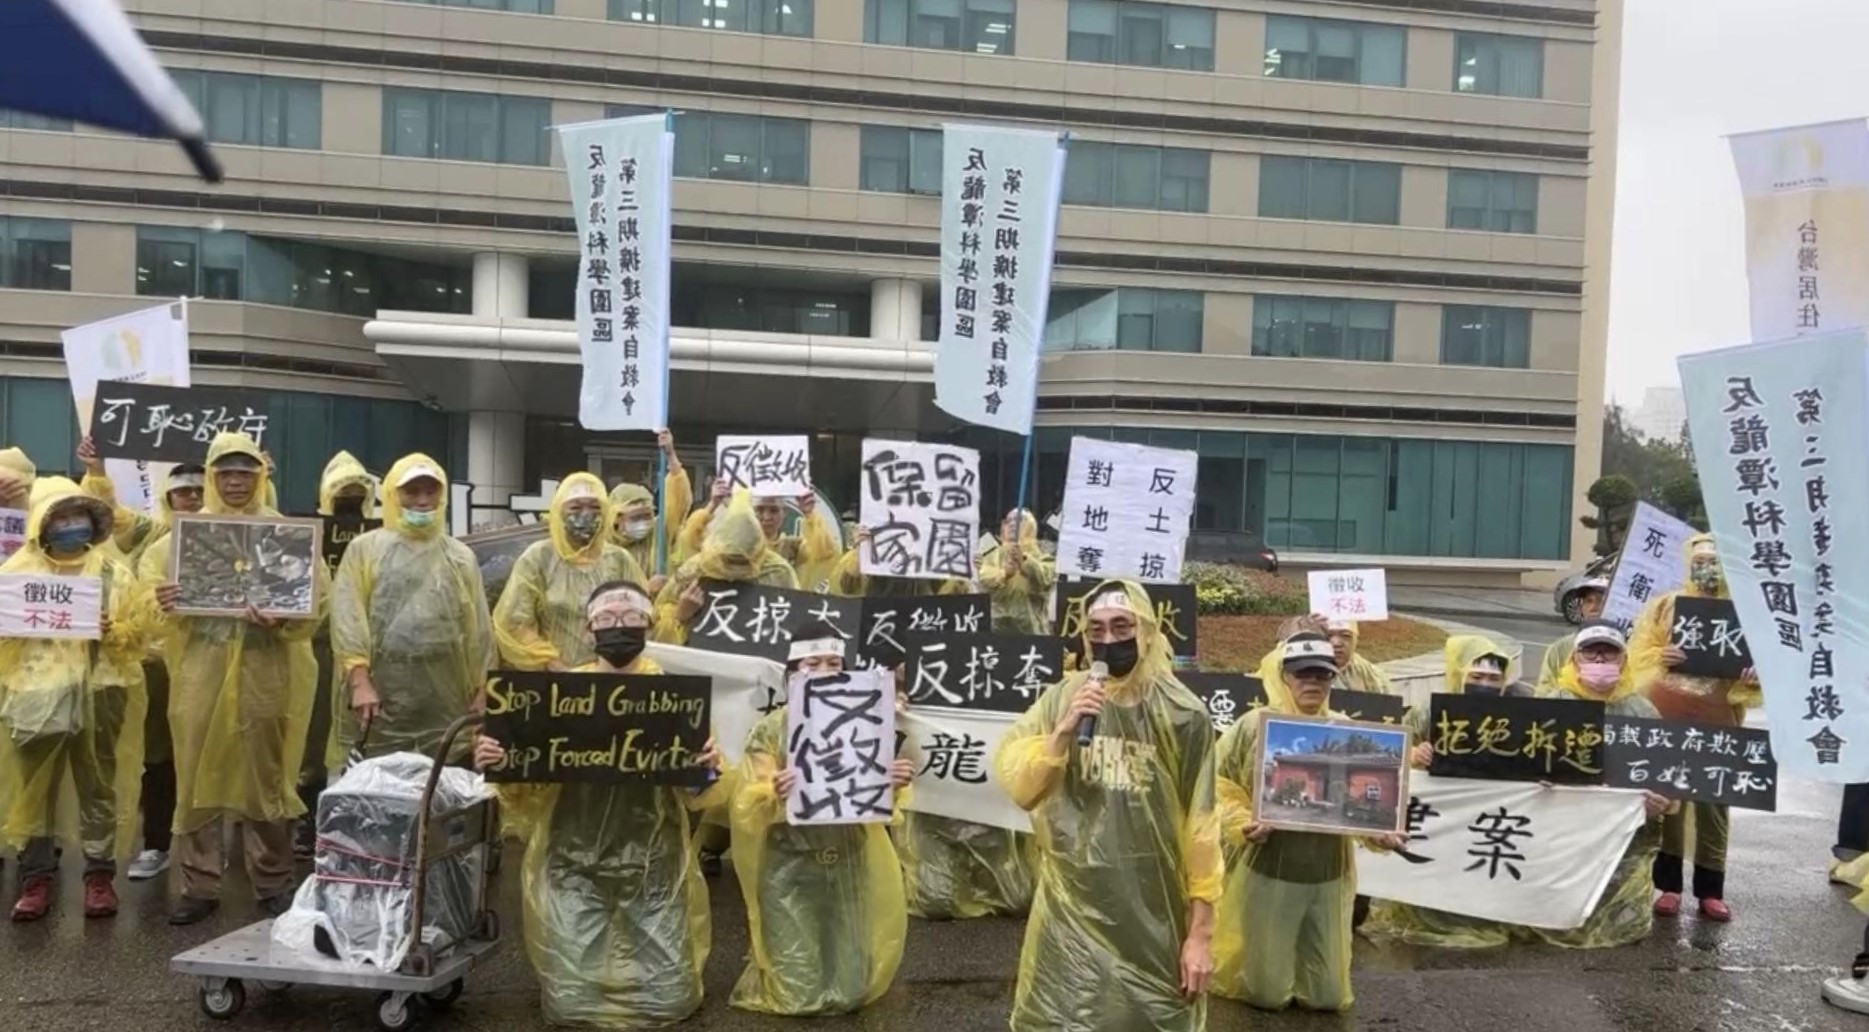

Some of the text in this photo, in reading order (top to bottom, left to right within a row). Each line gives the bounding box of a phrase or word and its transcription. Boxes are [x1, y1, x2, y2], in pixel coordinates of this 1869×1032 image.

[863, 449, 975, 512] 保留
[869, 511, 973, 578] 家園
[23, 582, 73, 605] 徵收
[1330, 597, 1366, 613] 不法
[23, 608, 72, 630] 不法
[1060, 598, 1188, 641] 反收
[1673, 615, 1743, 657] 強取
[484, 676, 541, 721] Stop
[551, 682, 596, 717] Land
[607, 684, 705, 729] Grabbing
[549, 734, 616, 772] Forced
[1434, 709, 1604, 775] 拒絕拆遷
